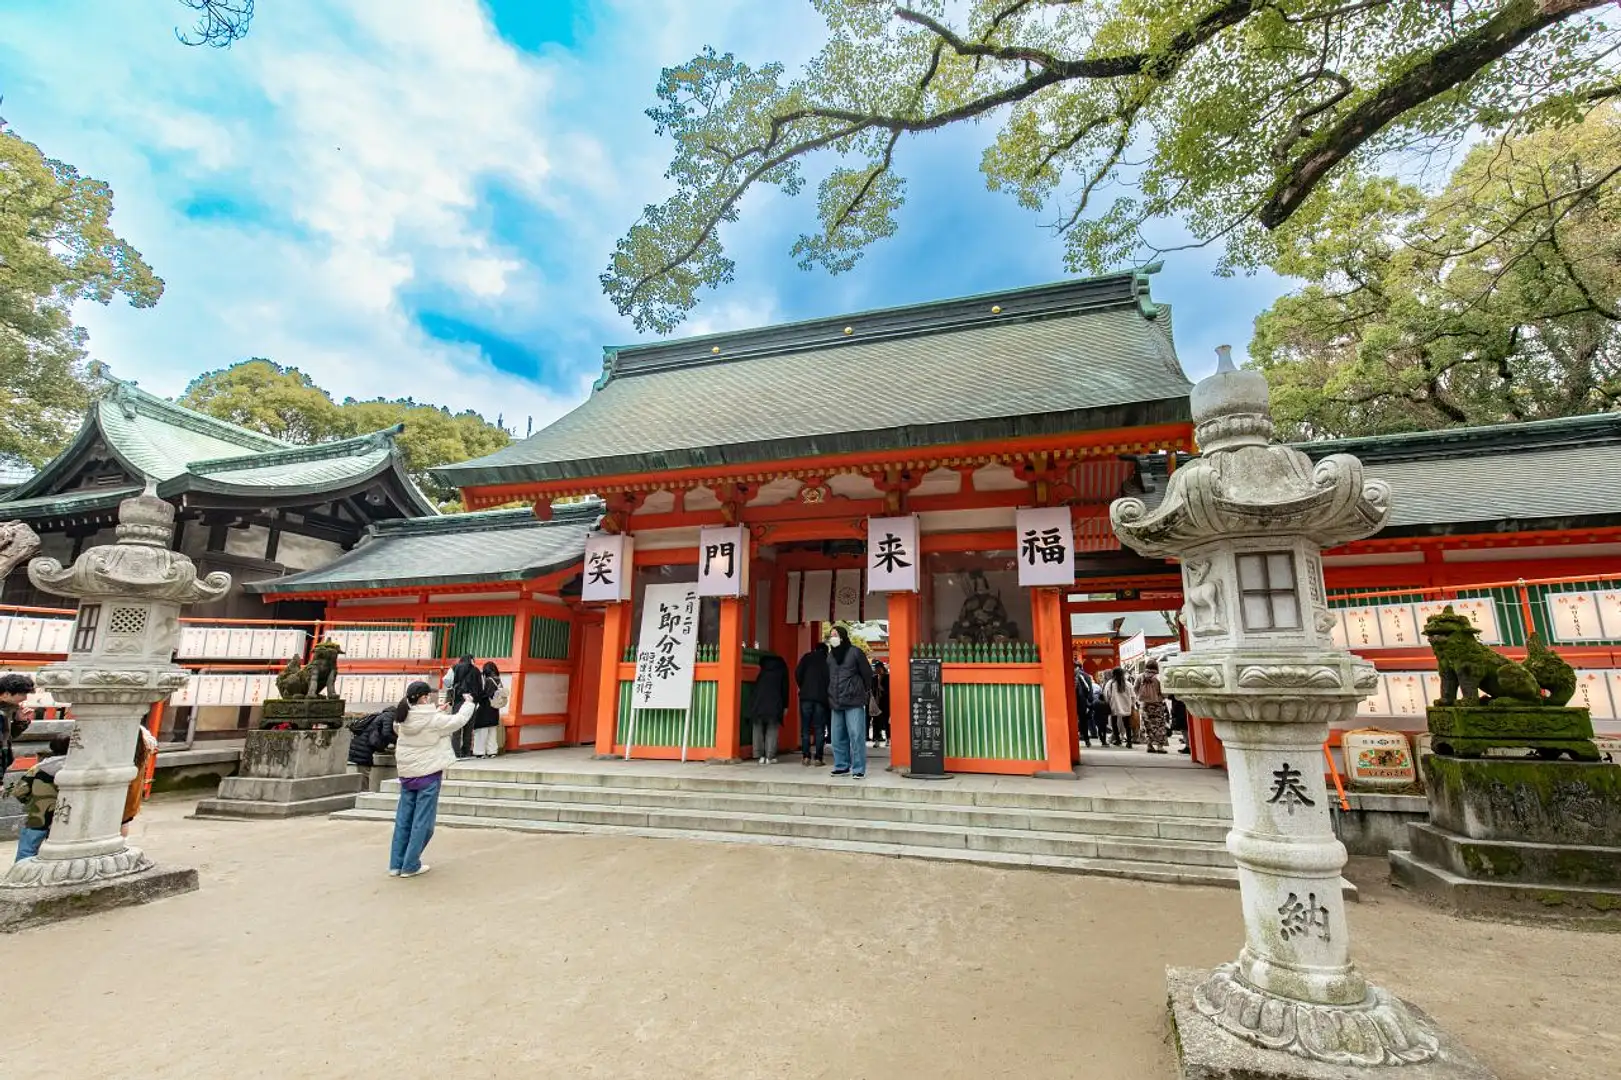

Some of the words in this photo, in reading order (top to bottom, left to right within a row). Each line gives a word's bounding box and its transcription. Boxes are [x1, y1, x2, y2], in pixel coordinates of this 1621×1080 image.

[703, 541, 735, 579] 門
[873, 533, 912, 573] 来
[1022, 527, 1066, 566] 福
[588, 551, 615, 585] 笑
[682, 591, 696, 635] 二月二日
[655, 602, 681, 680] 節分祭
